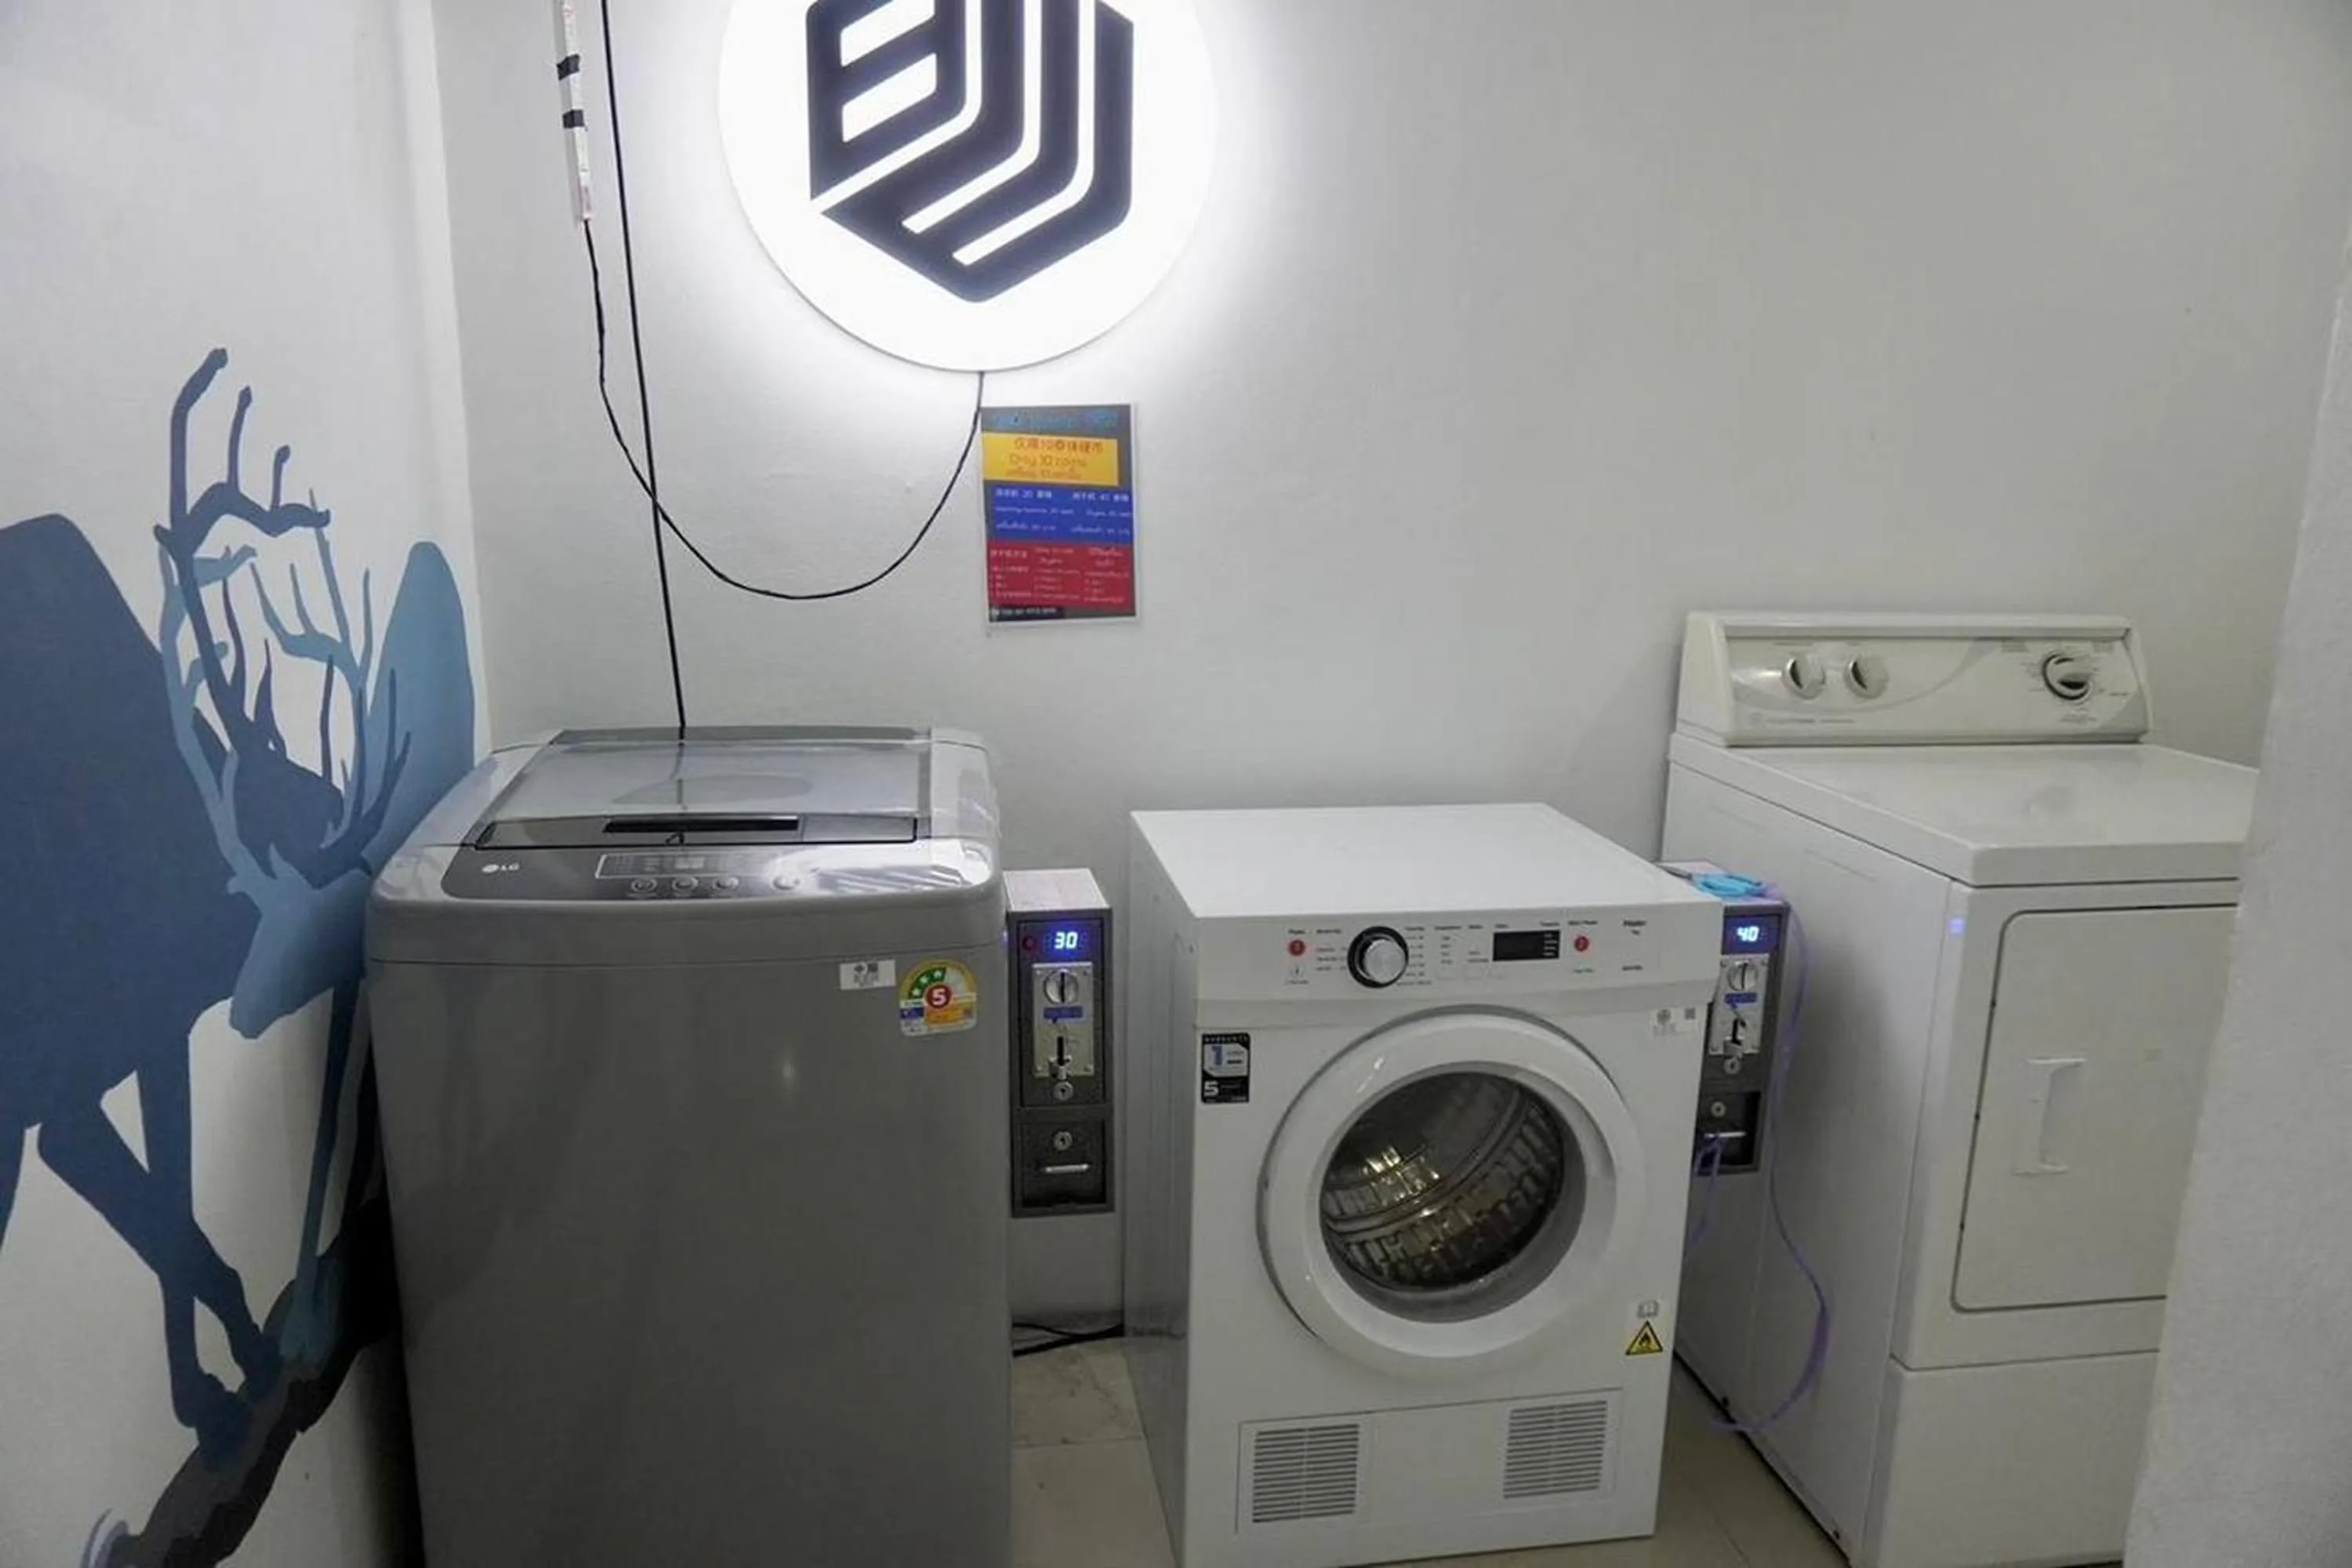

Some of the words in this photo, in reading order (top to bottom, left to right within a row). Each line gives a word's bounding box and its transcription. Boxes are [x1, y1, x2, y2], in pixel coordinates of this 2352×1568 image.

[1054, 931, 1079, 949] 30
[1737, 926, 1759, 942] 40
[932, 987, 947, 1006] 5
